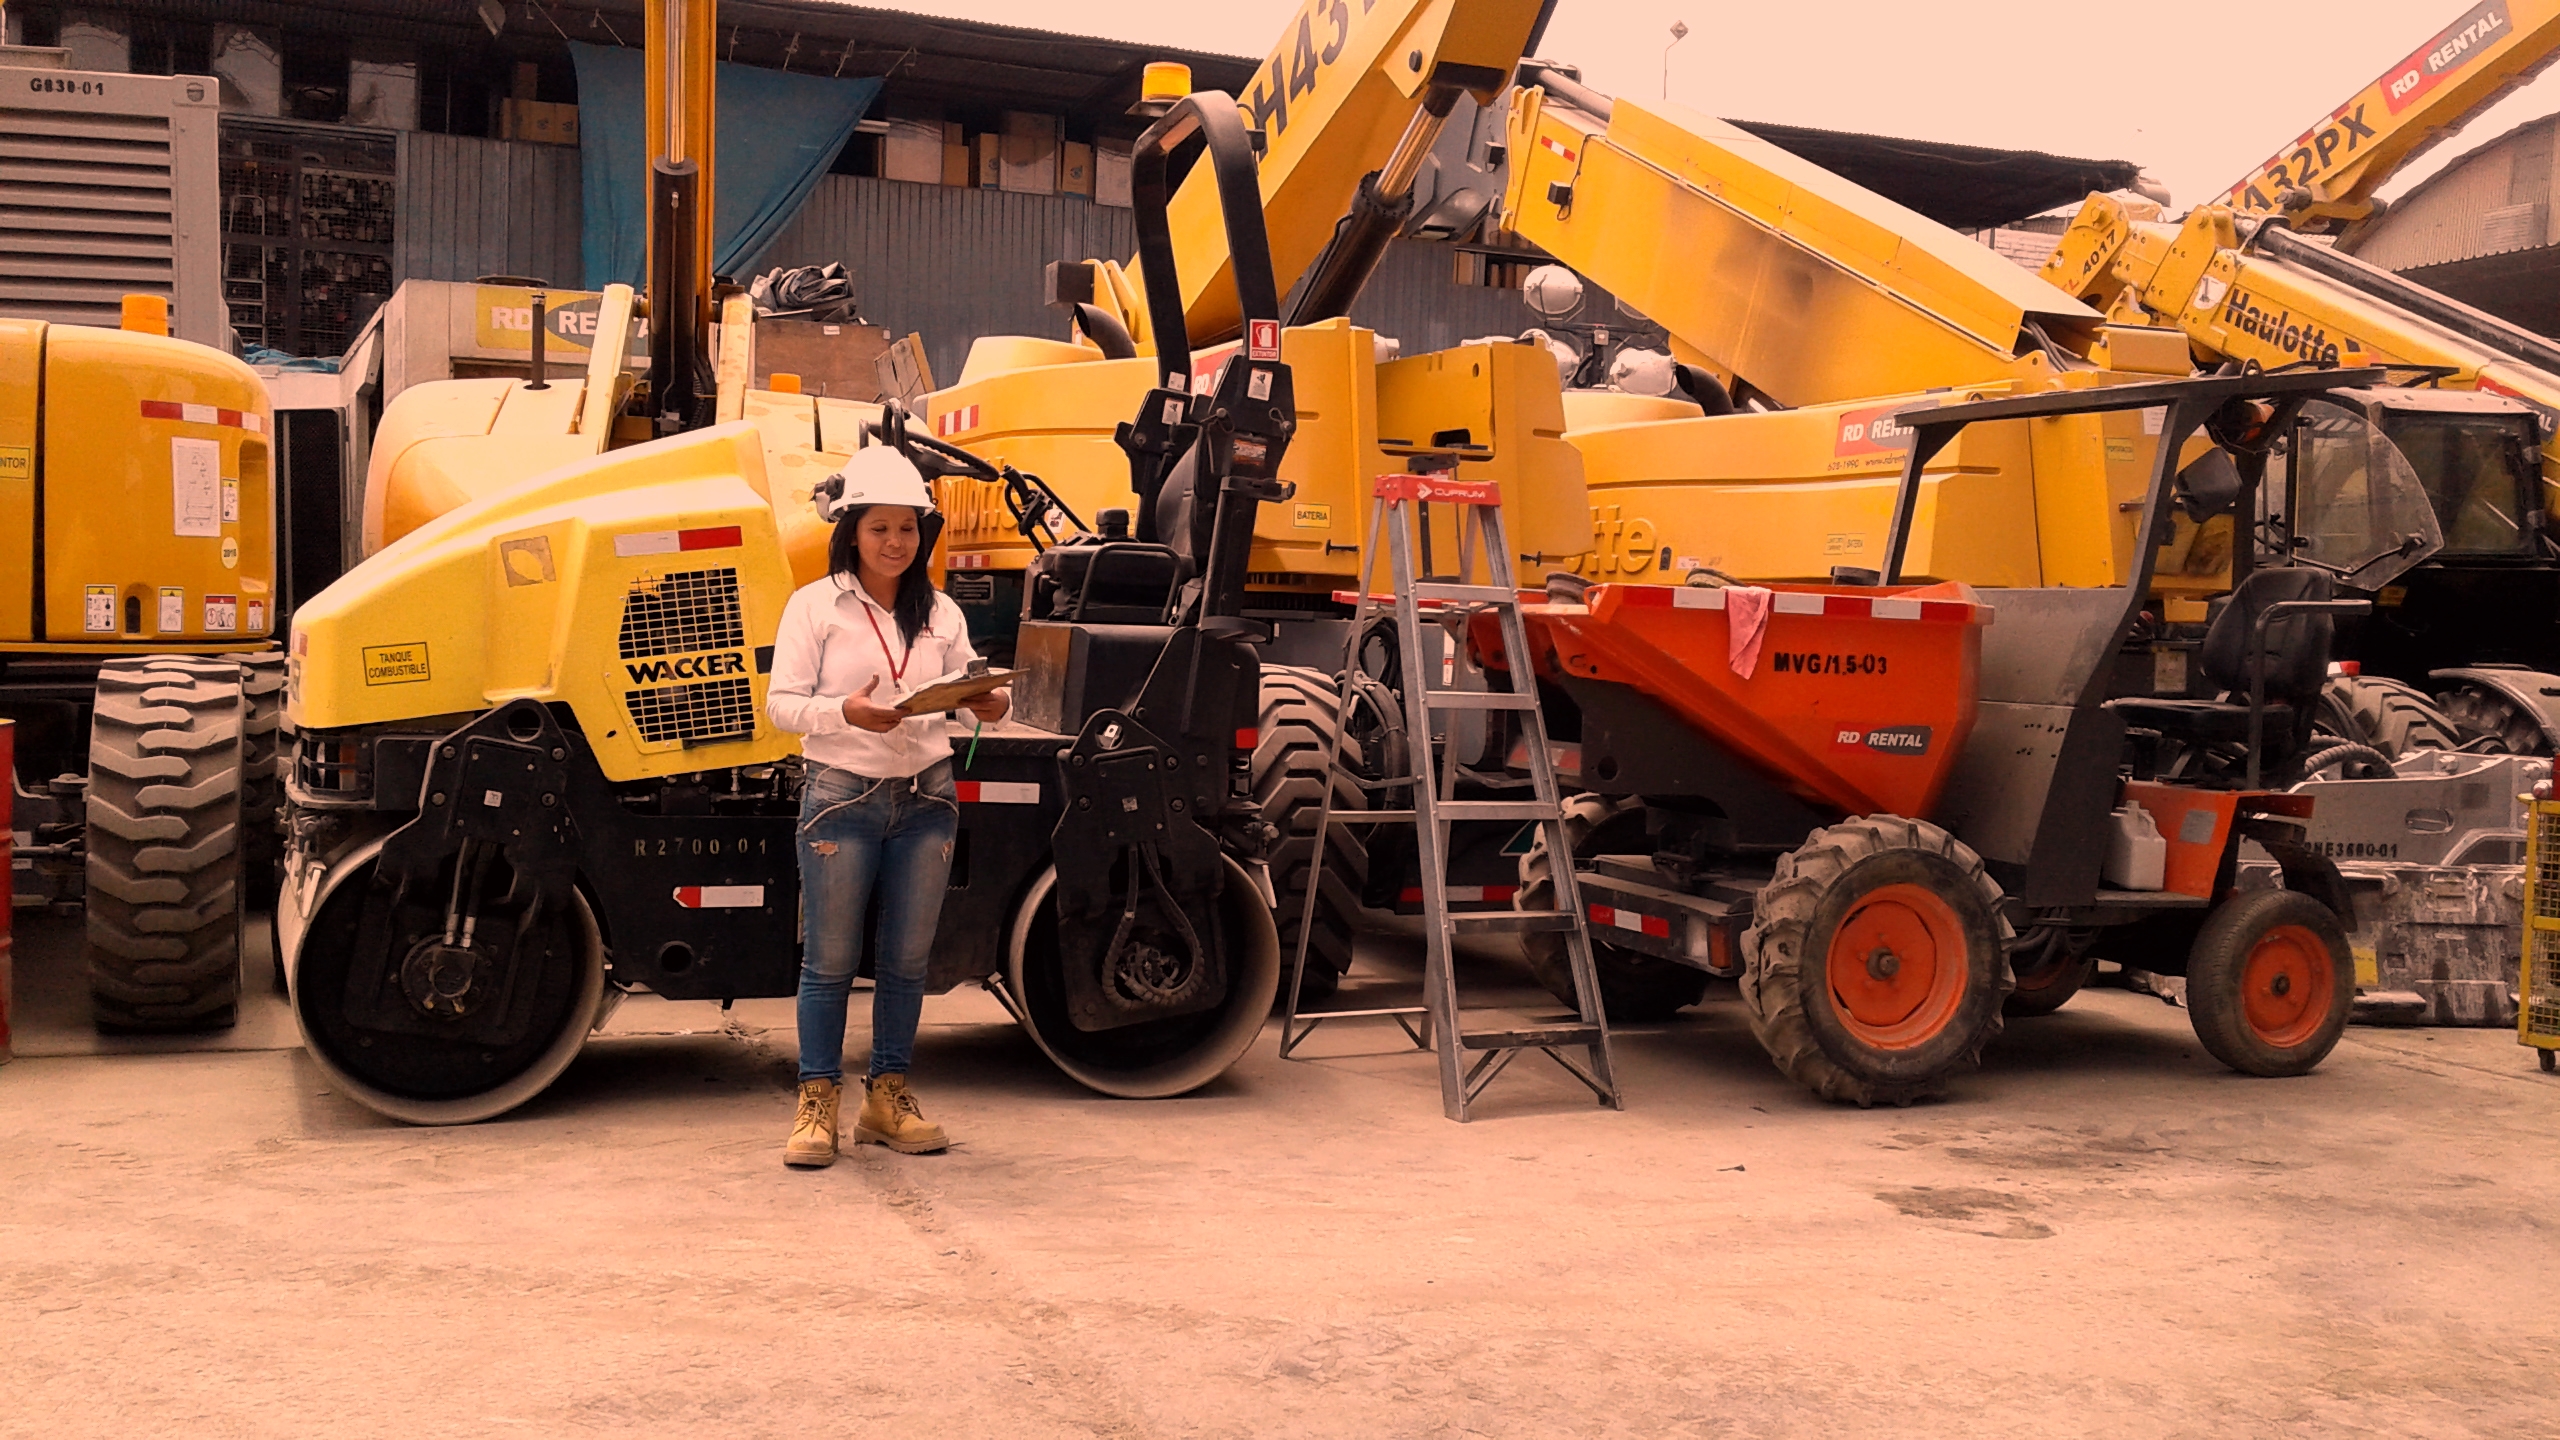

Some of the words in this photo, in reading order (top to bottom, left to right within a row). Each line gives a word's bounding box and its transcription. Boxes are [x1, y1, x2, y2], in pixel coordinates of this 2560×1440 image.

[2390, 70, 2420, 100] RD
[2428, 12, 2503, 72] RENTAL
[1252, 0, 1376, 164] H43
[2223, 103, 2377, 211] A32PX
[2082, 228, 2115, 279] 4017
[2225, 288, 2339, 366] Haulotte
[1842, 423, 1864, 443] RD
[1434, 487, 1486, 499] CUPRUM
[1296, 510, 1328, 521] BATERIA
[368, 663, 427, 678] COMBUSTIBLE
[379, 651, 413, 664] TANQUE
[625, 652, 747, 685] WACKER
[1837, 731, 1861, 744] RD
[1868, 732, 1923, 748] RENTAL
